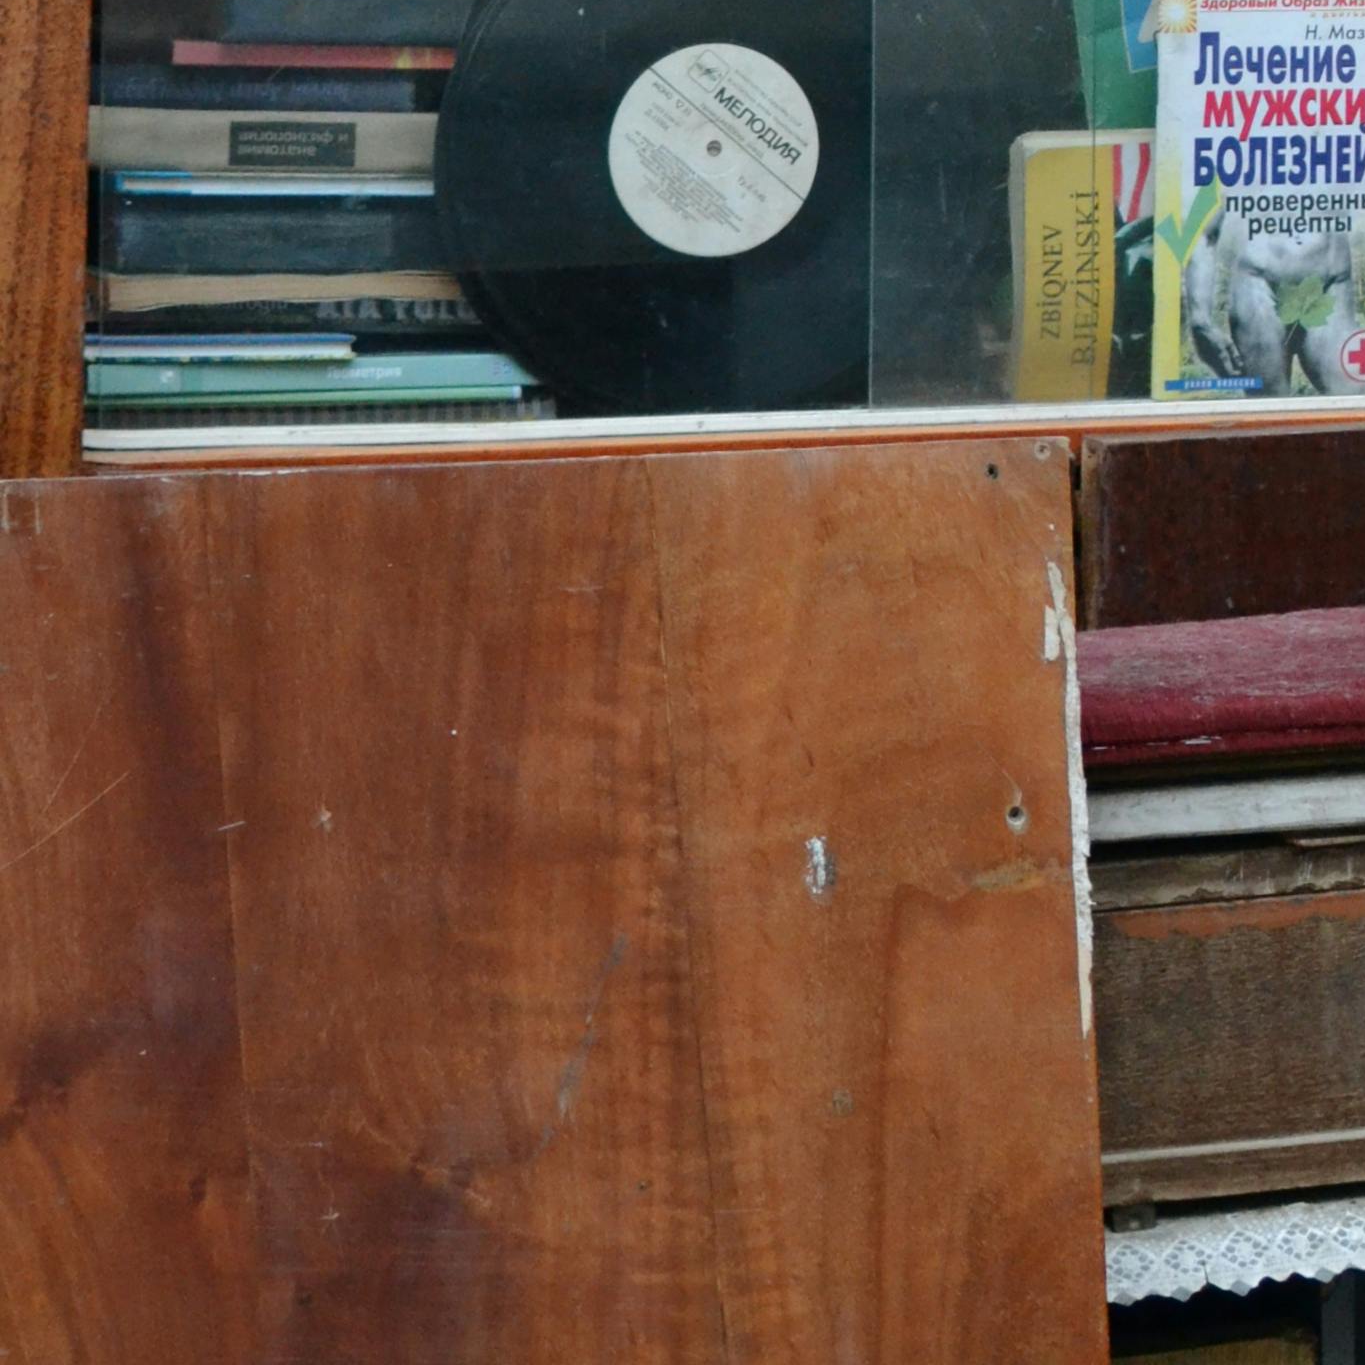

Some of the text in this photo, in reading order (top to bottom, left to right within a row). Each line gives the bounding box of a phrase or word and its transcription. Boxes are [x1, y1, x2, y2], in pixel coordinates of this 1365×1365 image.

[1195, 32, 1357, 87] Лечение
[1305, 24, 1323, 40] Н.
[713, 85, 802, 167] МЕЛОДИЯ
[1247, 215, 1353, 241] рецепты
[1036, 224, 1067, 341] ZBİQNEV
[1069, 189, 1101, 368] BJEZİNSKİ
